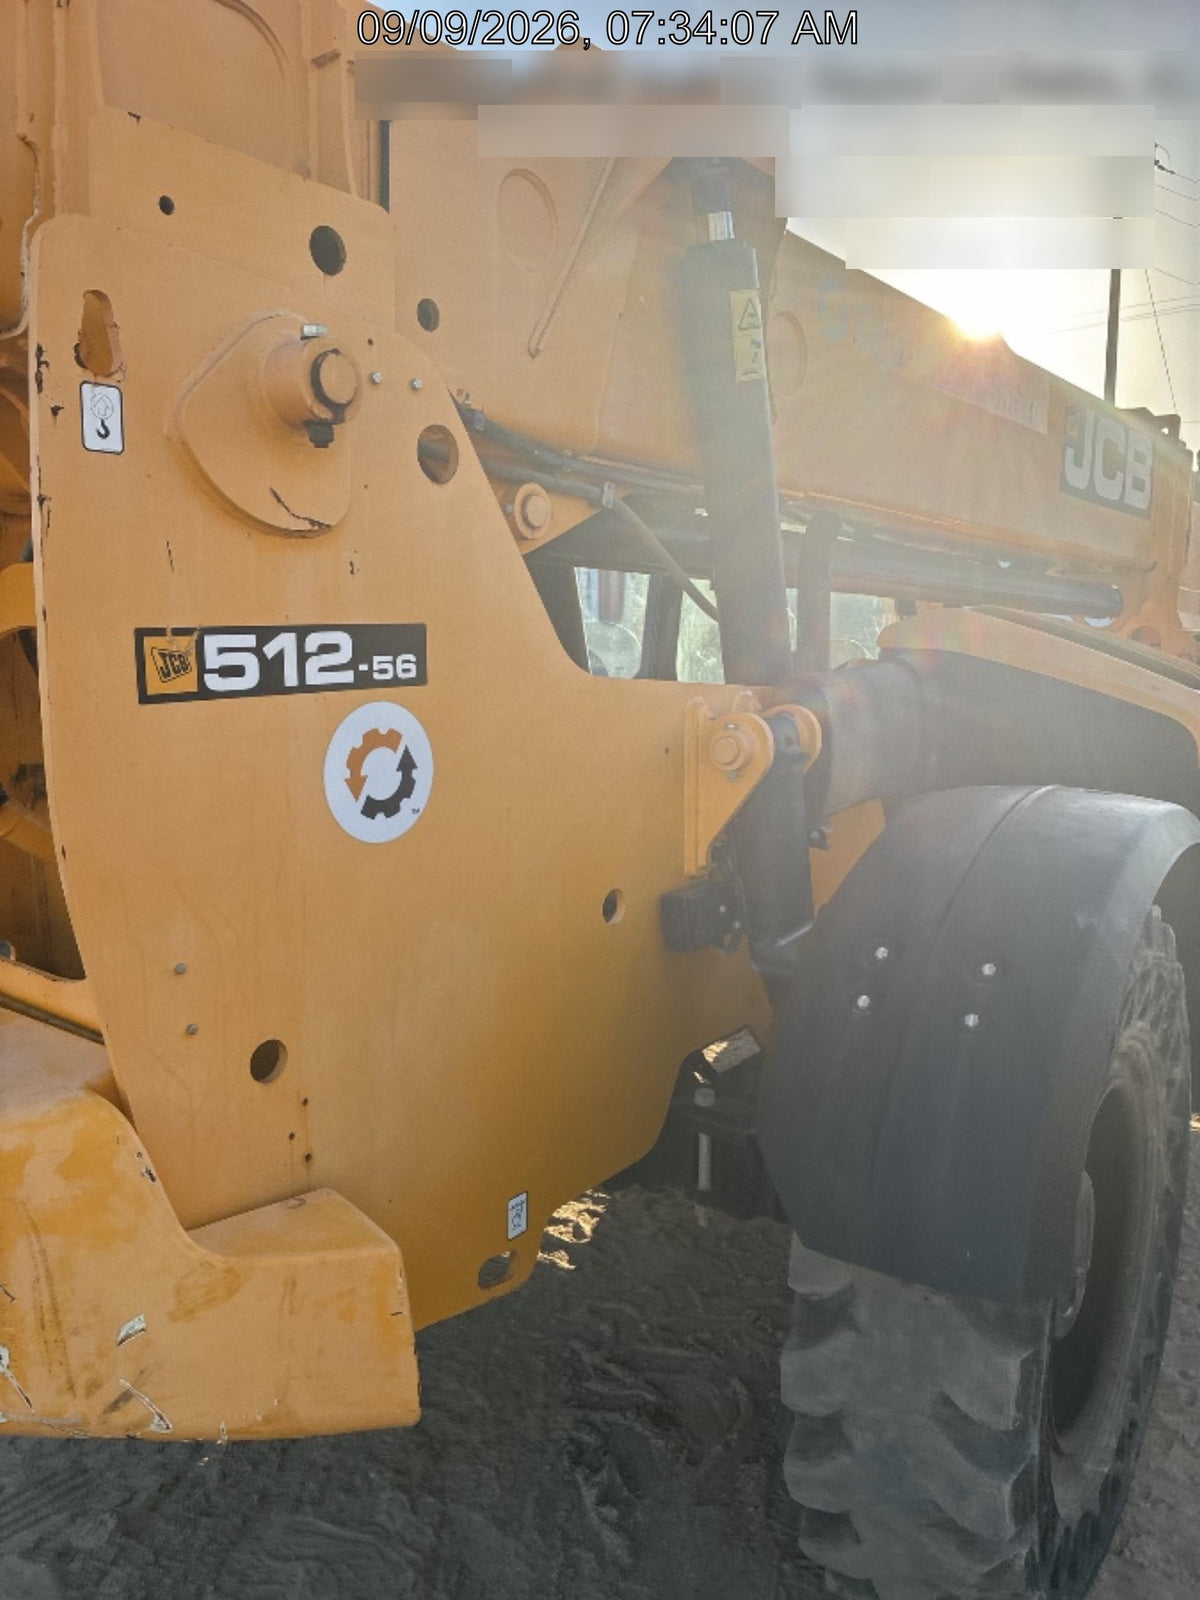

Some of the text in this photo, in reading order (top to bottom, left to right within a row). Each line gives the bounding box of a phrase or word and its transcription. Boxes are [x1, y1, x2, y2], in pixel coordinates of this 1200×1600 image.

[1064, 407, 1154, 510] JCB
[157, 651, 190, 680] JCB
[203, 630, 418, 692] 512-56
